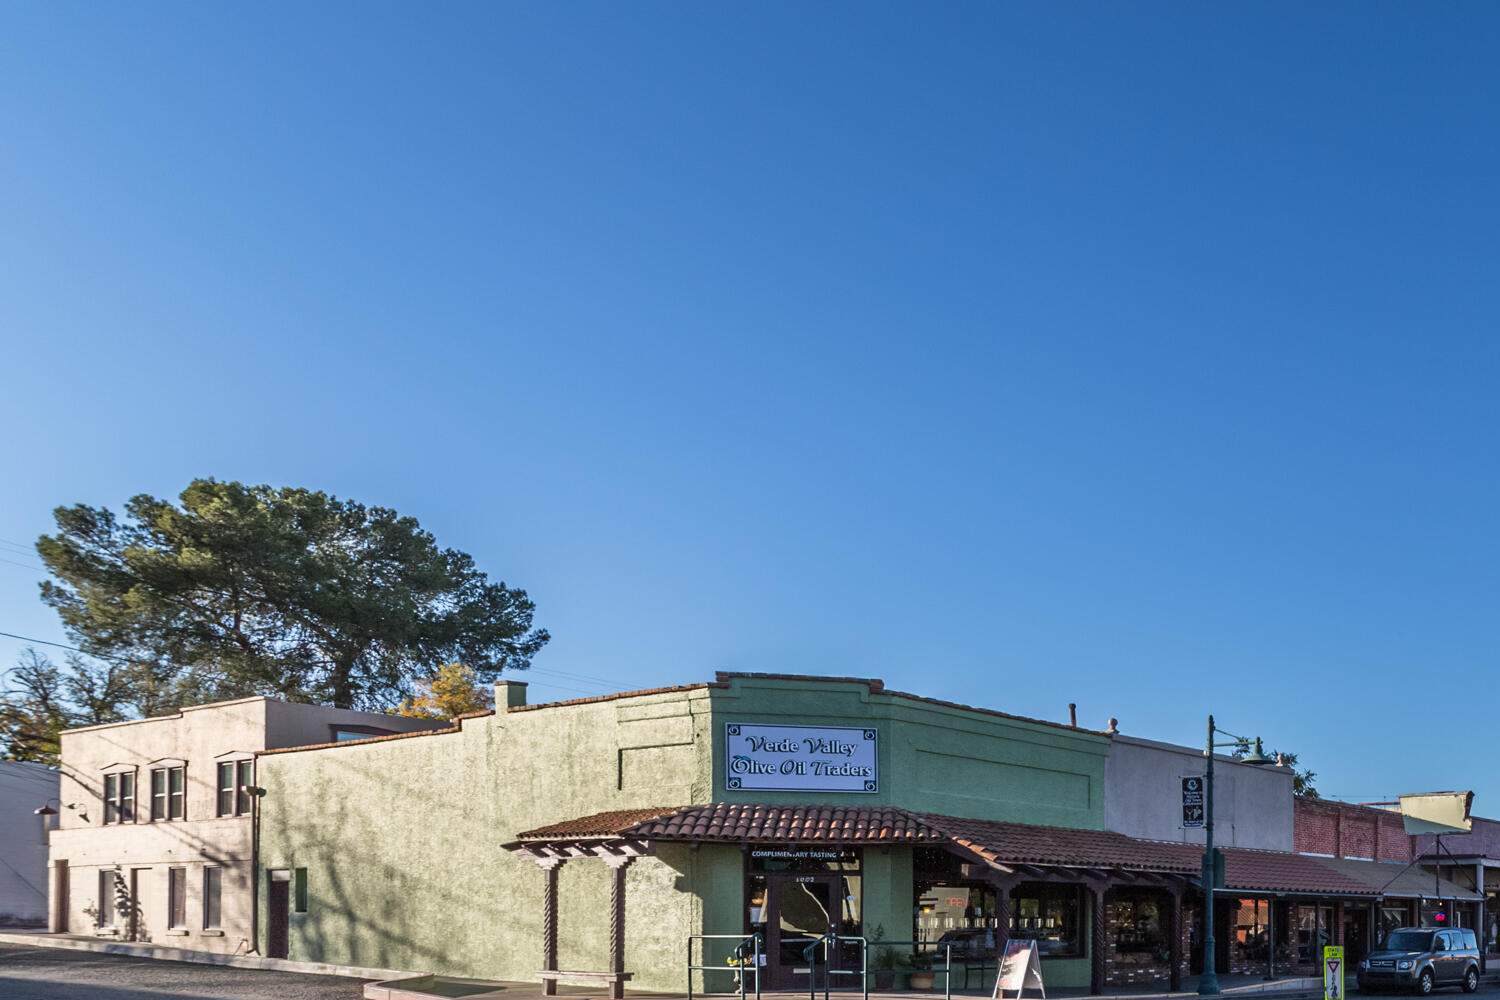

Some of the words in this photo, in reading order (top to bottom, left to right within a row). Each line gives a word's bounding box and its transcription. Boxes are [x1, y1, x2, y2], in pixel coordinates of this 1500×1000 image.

[745, 736, 800, 752] Verde
[803, 738, 857, 756] Valley
[731, 756, 777, 774] Olive
[780, 760, 807, 775] Oil
[810, 760, 872, 776] Traders
